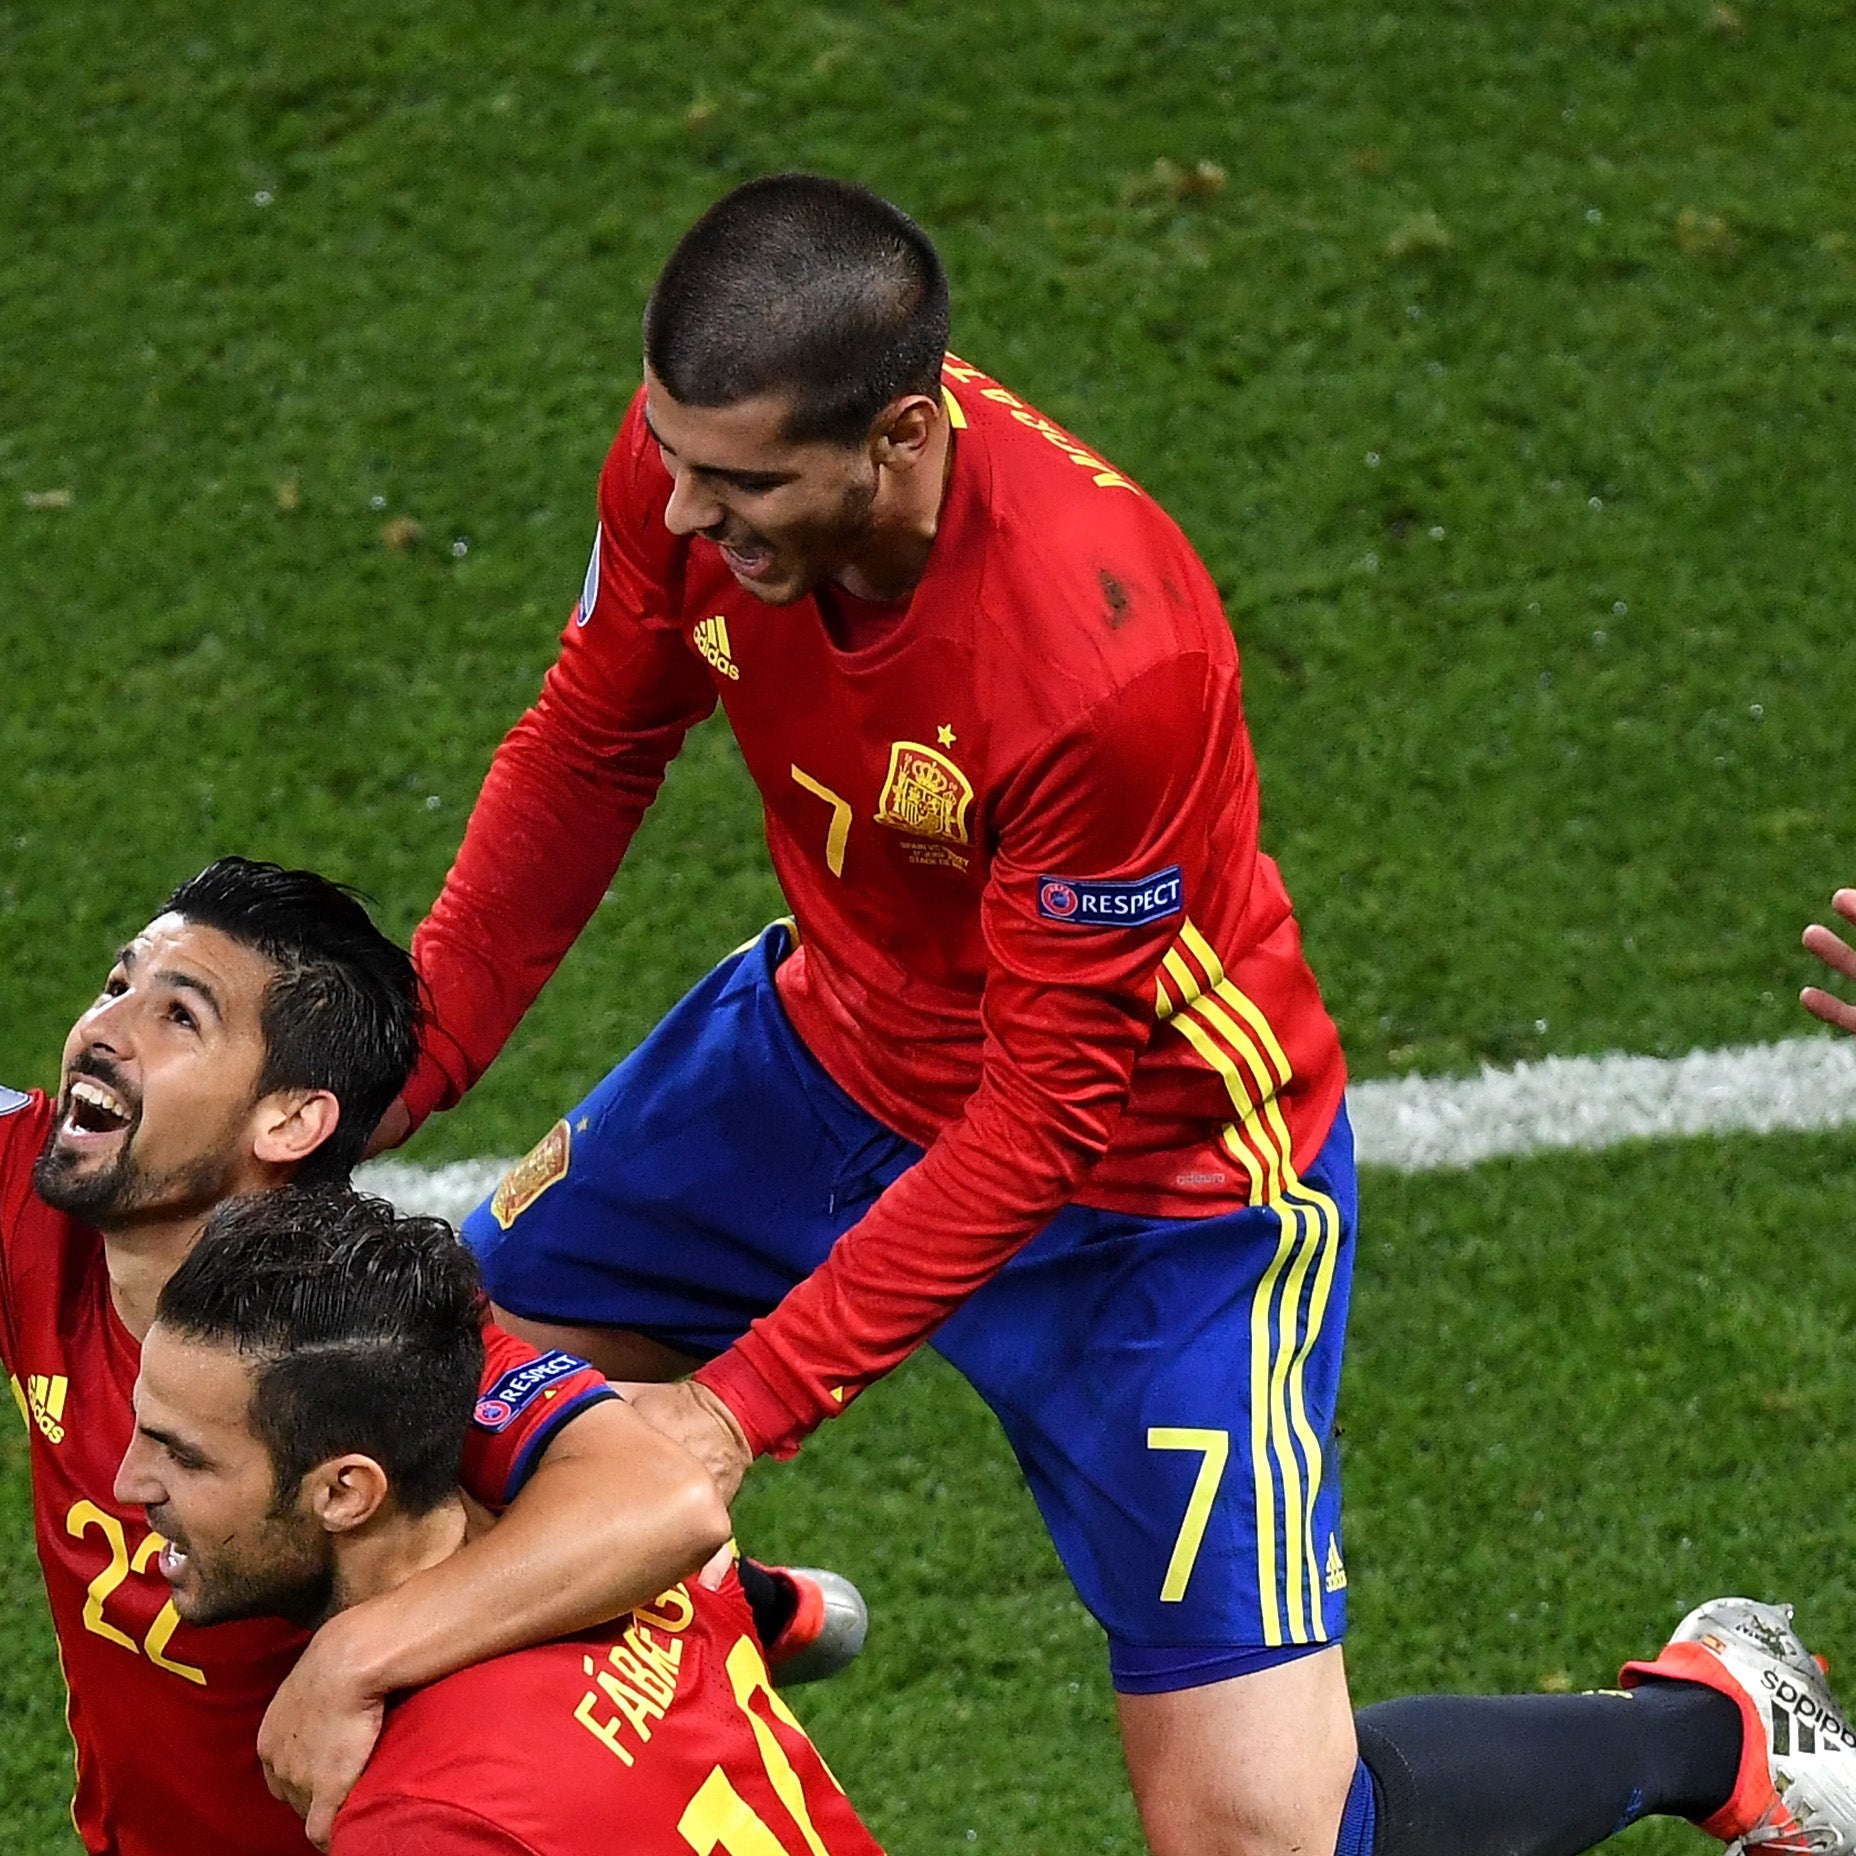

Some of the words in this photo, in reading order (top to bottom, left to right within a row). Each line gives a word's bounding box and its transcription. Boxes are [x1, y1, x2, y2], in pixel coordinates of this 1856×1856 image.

[942, 351, 1142, 496] MORAT
[693, 625, 740, 681] adidas
[791, 764, 853, 878] 7
[1081, 878, 1180, 915] RESPECT
[498, 1354, 579, 1403] RESPECT
[1147, 1427, 1229, 1602] 7
[66, 1498, 208, 1686] 22
[573, 1581, 696, 1768] FÁBREG
